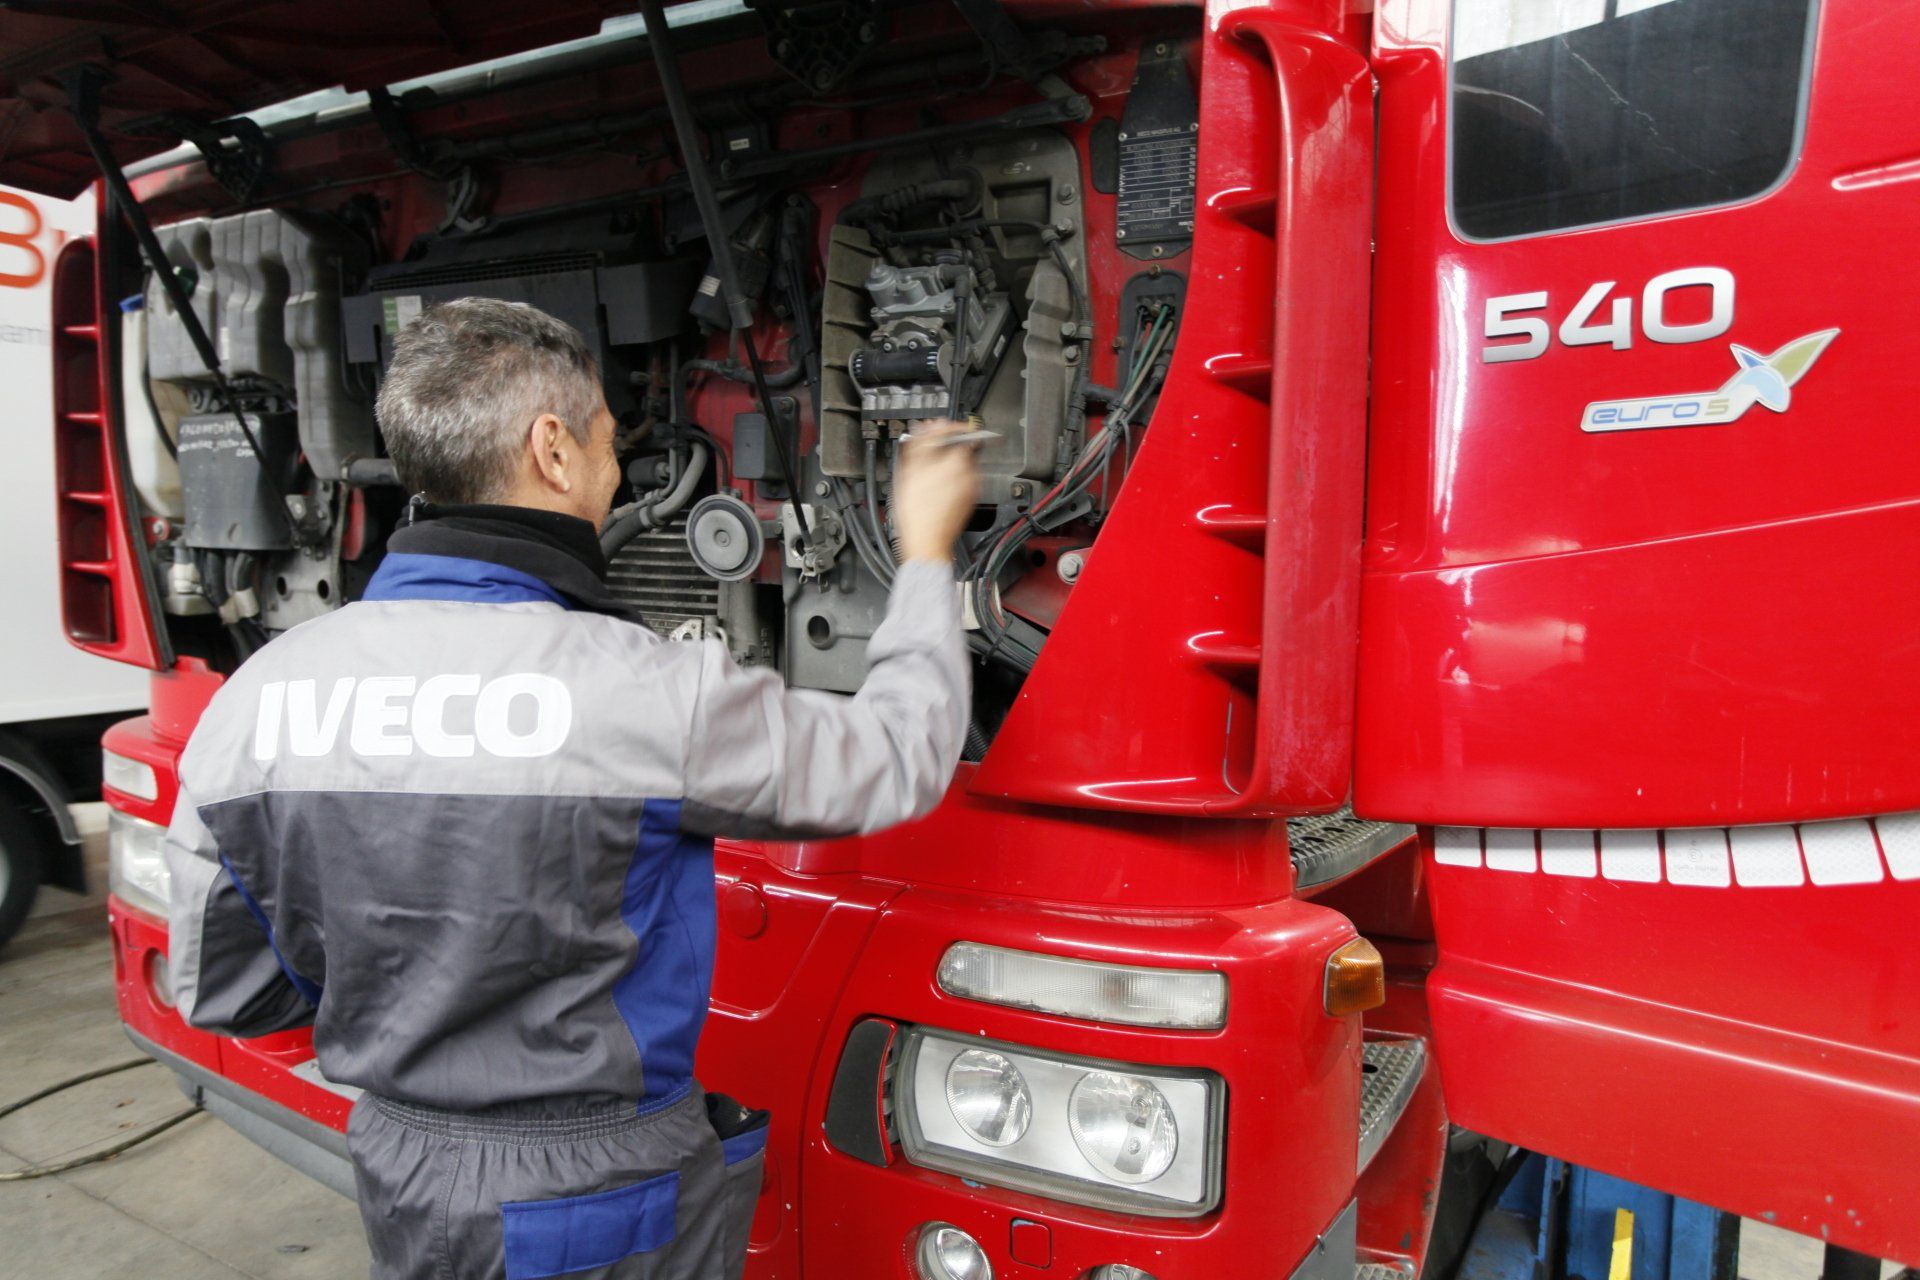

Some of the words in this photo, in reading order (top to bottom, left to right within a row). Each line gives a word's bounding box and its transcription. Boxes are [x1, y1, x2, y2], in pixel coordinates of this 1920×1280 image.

[1482, 266, 1735, 363] 540
[1591, 401, 1700, 425] euro
[1704, 398, 1731, 416] 5
[254, 673, 573, 760] IVECO
